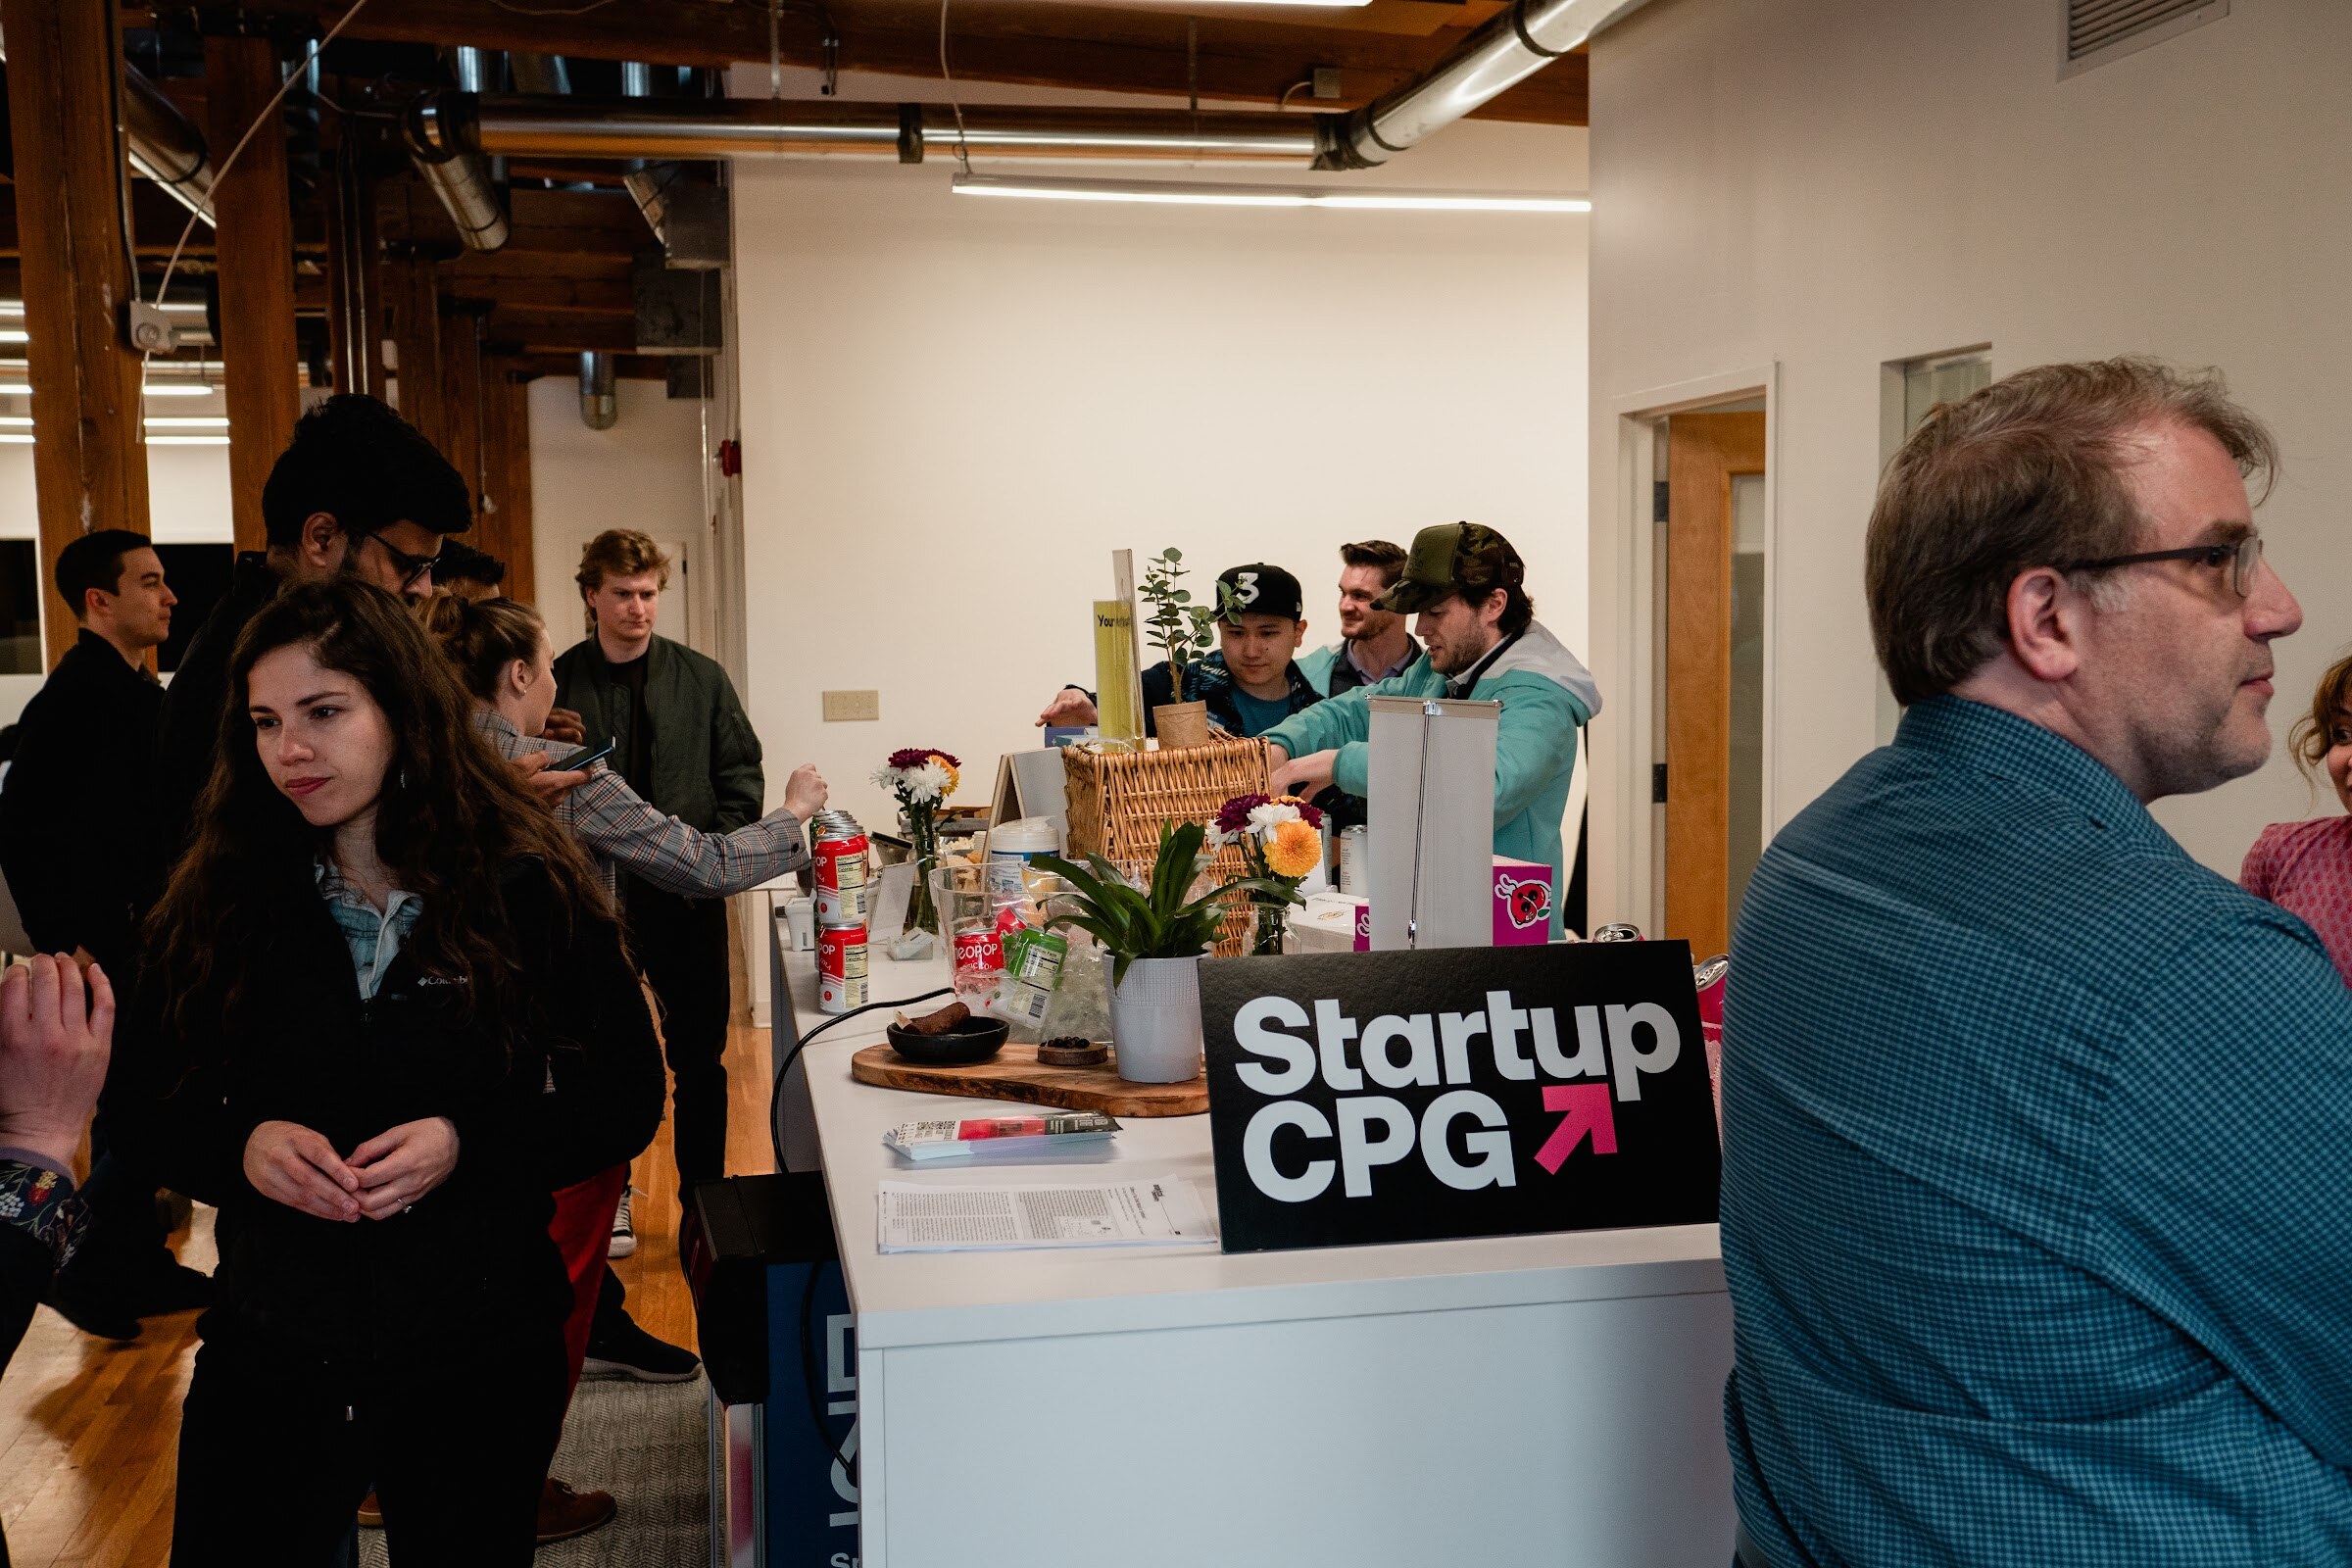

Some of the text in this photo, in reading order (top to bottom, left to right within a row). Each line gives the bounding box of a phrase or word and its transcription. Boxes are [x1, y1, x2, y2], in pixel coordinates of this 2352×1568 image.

[1236, 571, 1260, 605] 3
[1233, 990, 1681, 1102] Startup
[1243, 1089, 1517, 1203] CPG
